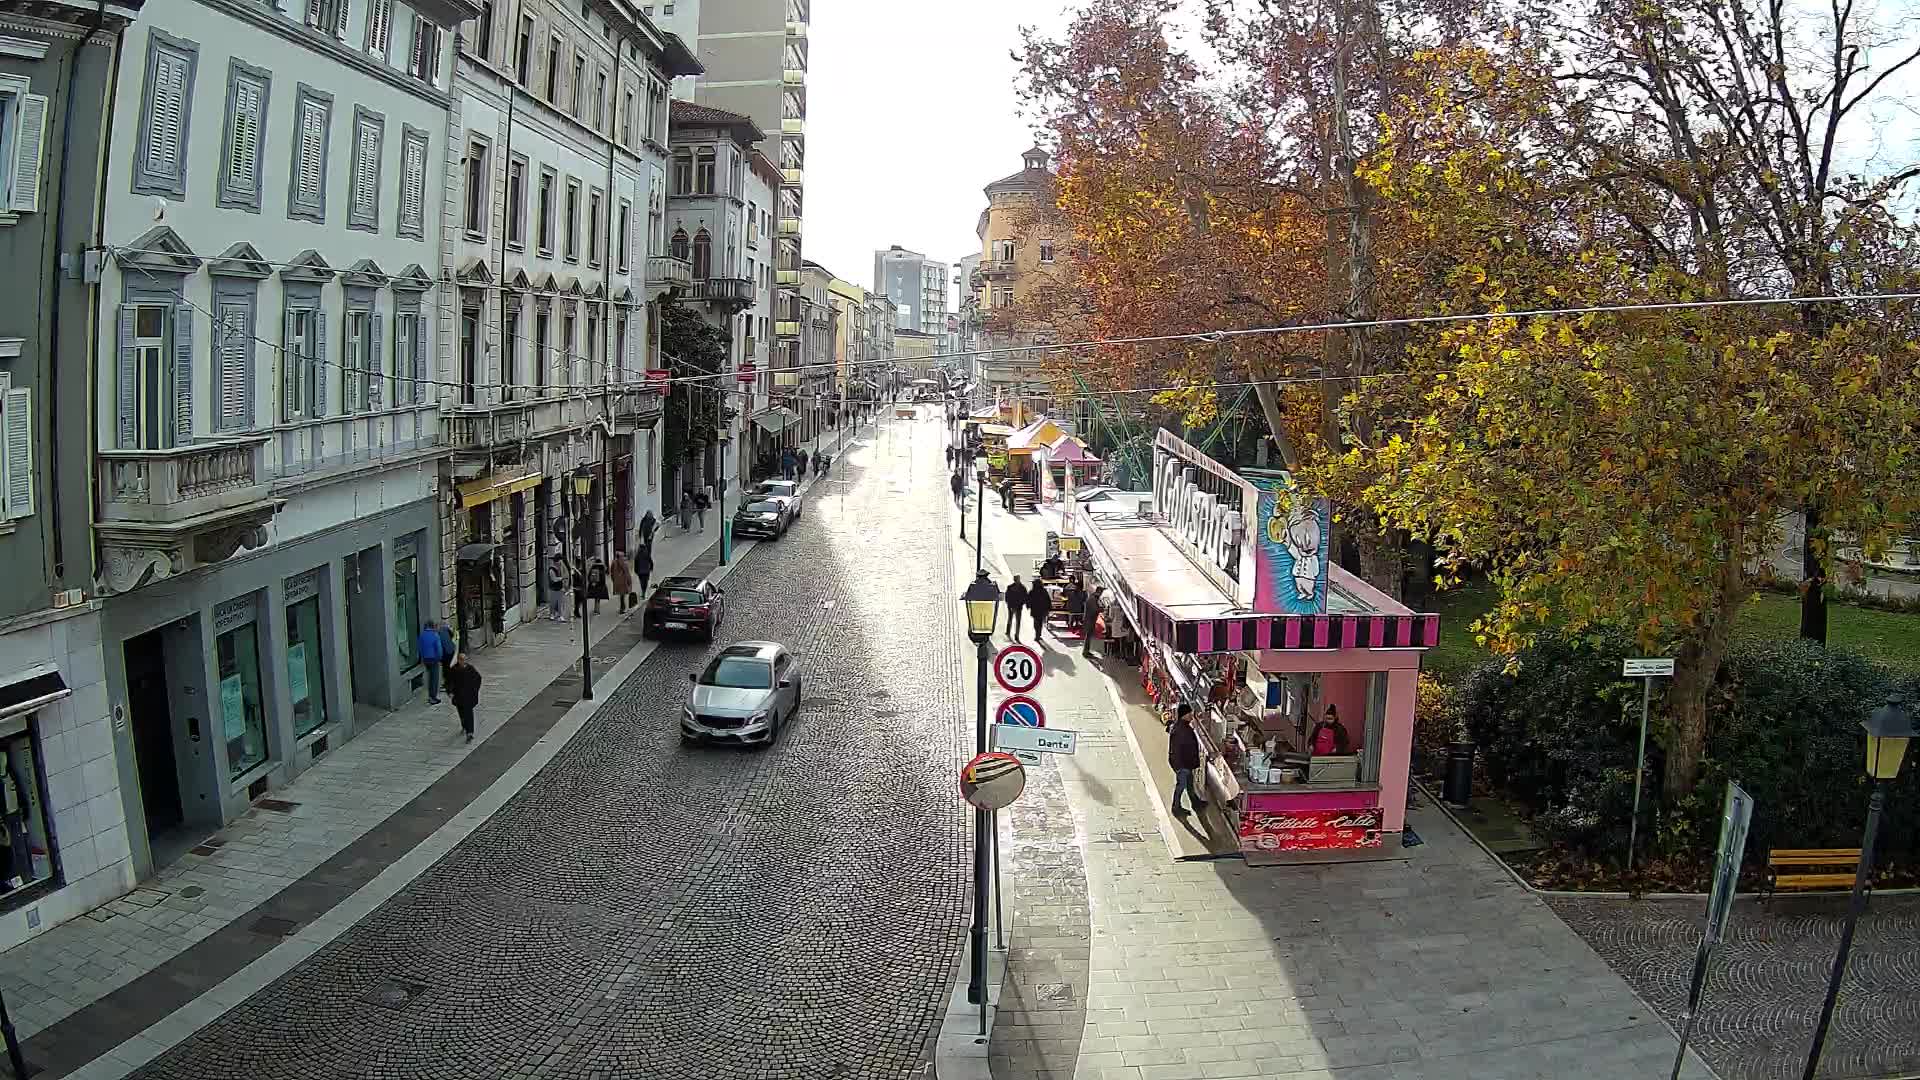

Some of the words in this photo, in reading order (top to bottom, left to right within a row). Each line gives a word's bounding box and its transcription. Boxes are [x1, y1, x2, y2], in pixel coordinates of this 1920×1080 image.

[1005, 659, 1033, 680] 30
[1038, 738, 1069, 749] Dante
[1324, 815, 1376, 828] Calde
